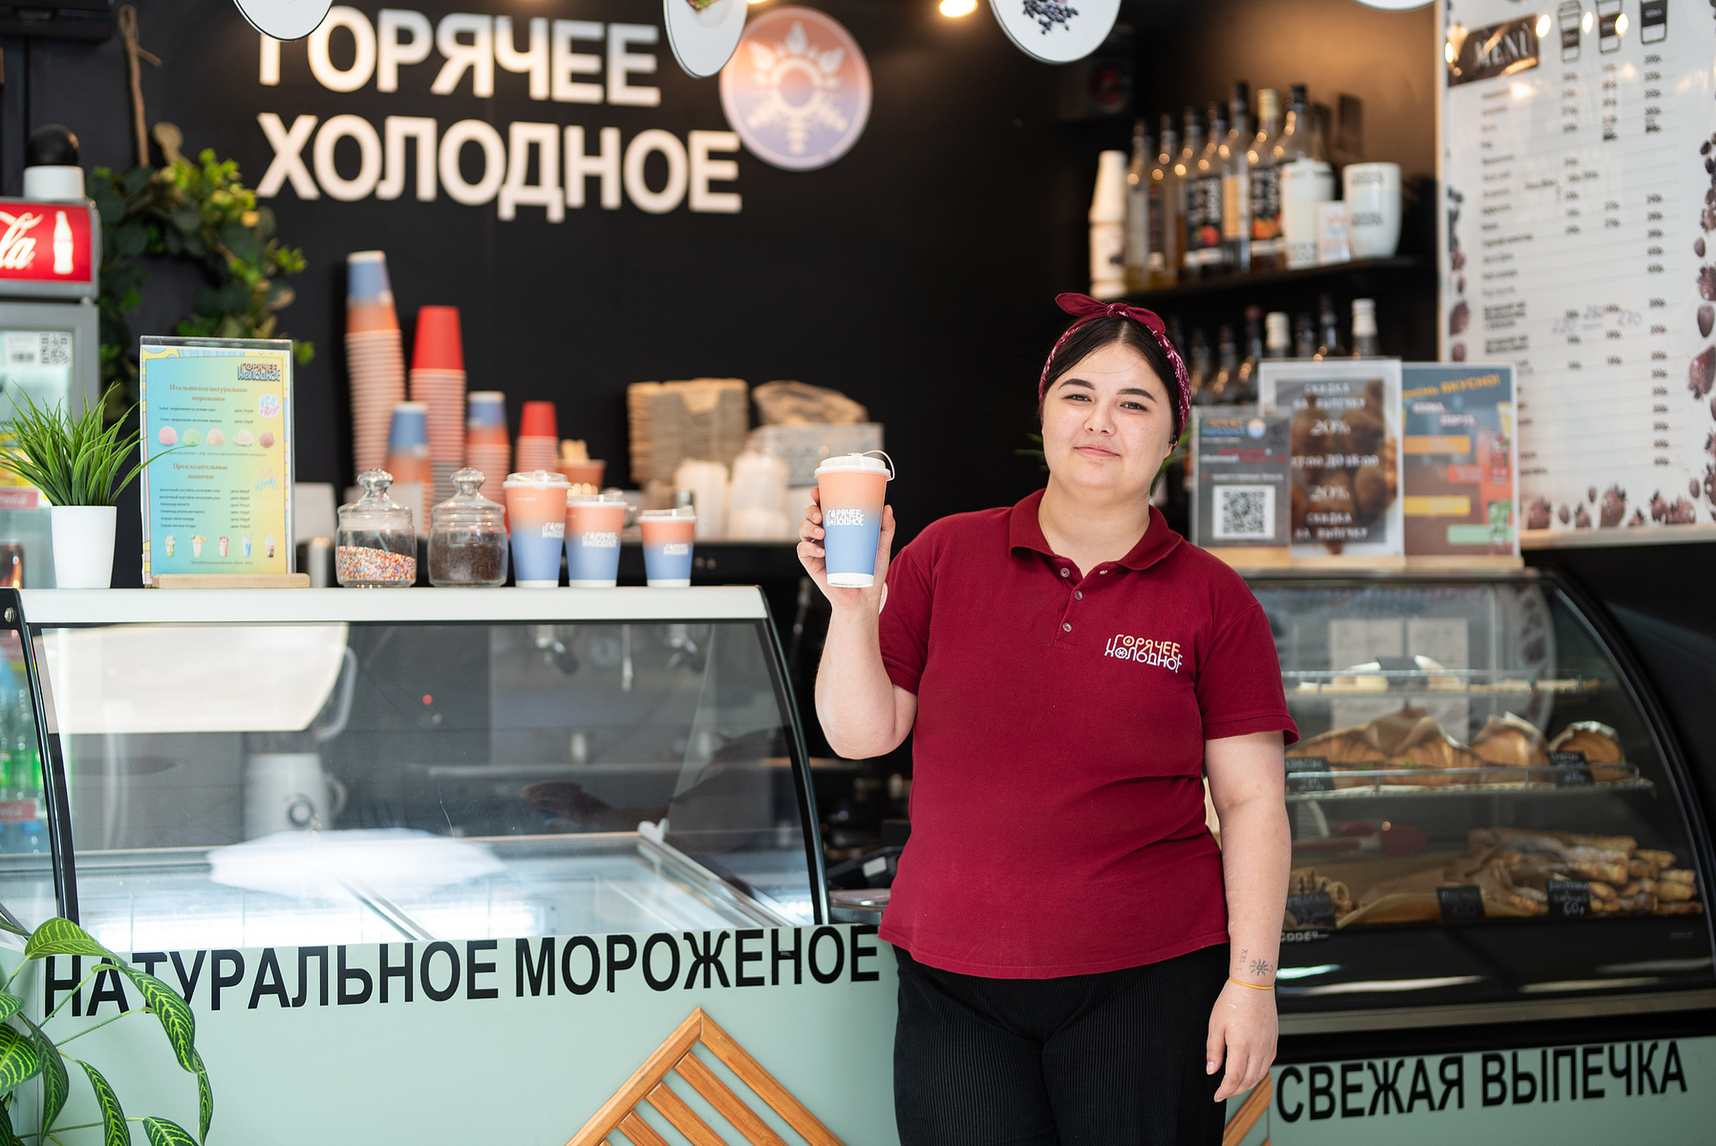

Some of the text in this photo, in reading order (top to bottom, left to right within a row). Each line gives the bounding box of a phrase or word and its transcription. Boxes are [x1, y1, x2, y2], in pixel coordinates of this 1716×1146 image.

[255, 112, 742, 223] ХОЛОДНОЕ
[1104, 638, 1183, 673] ХОЛОДНОЕ
[1112, 634, 1181, 660] ГОРЯЧЕЕ
[44, 925, 880, 1017] НАТУРАЛЬНОЕ МОРОЖЕНОЕ
[1276, 1040, 1687, 1123] СВЕЖАЯ ВЫПЕЧКА
